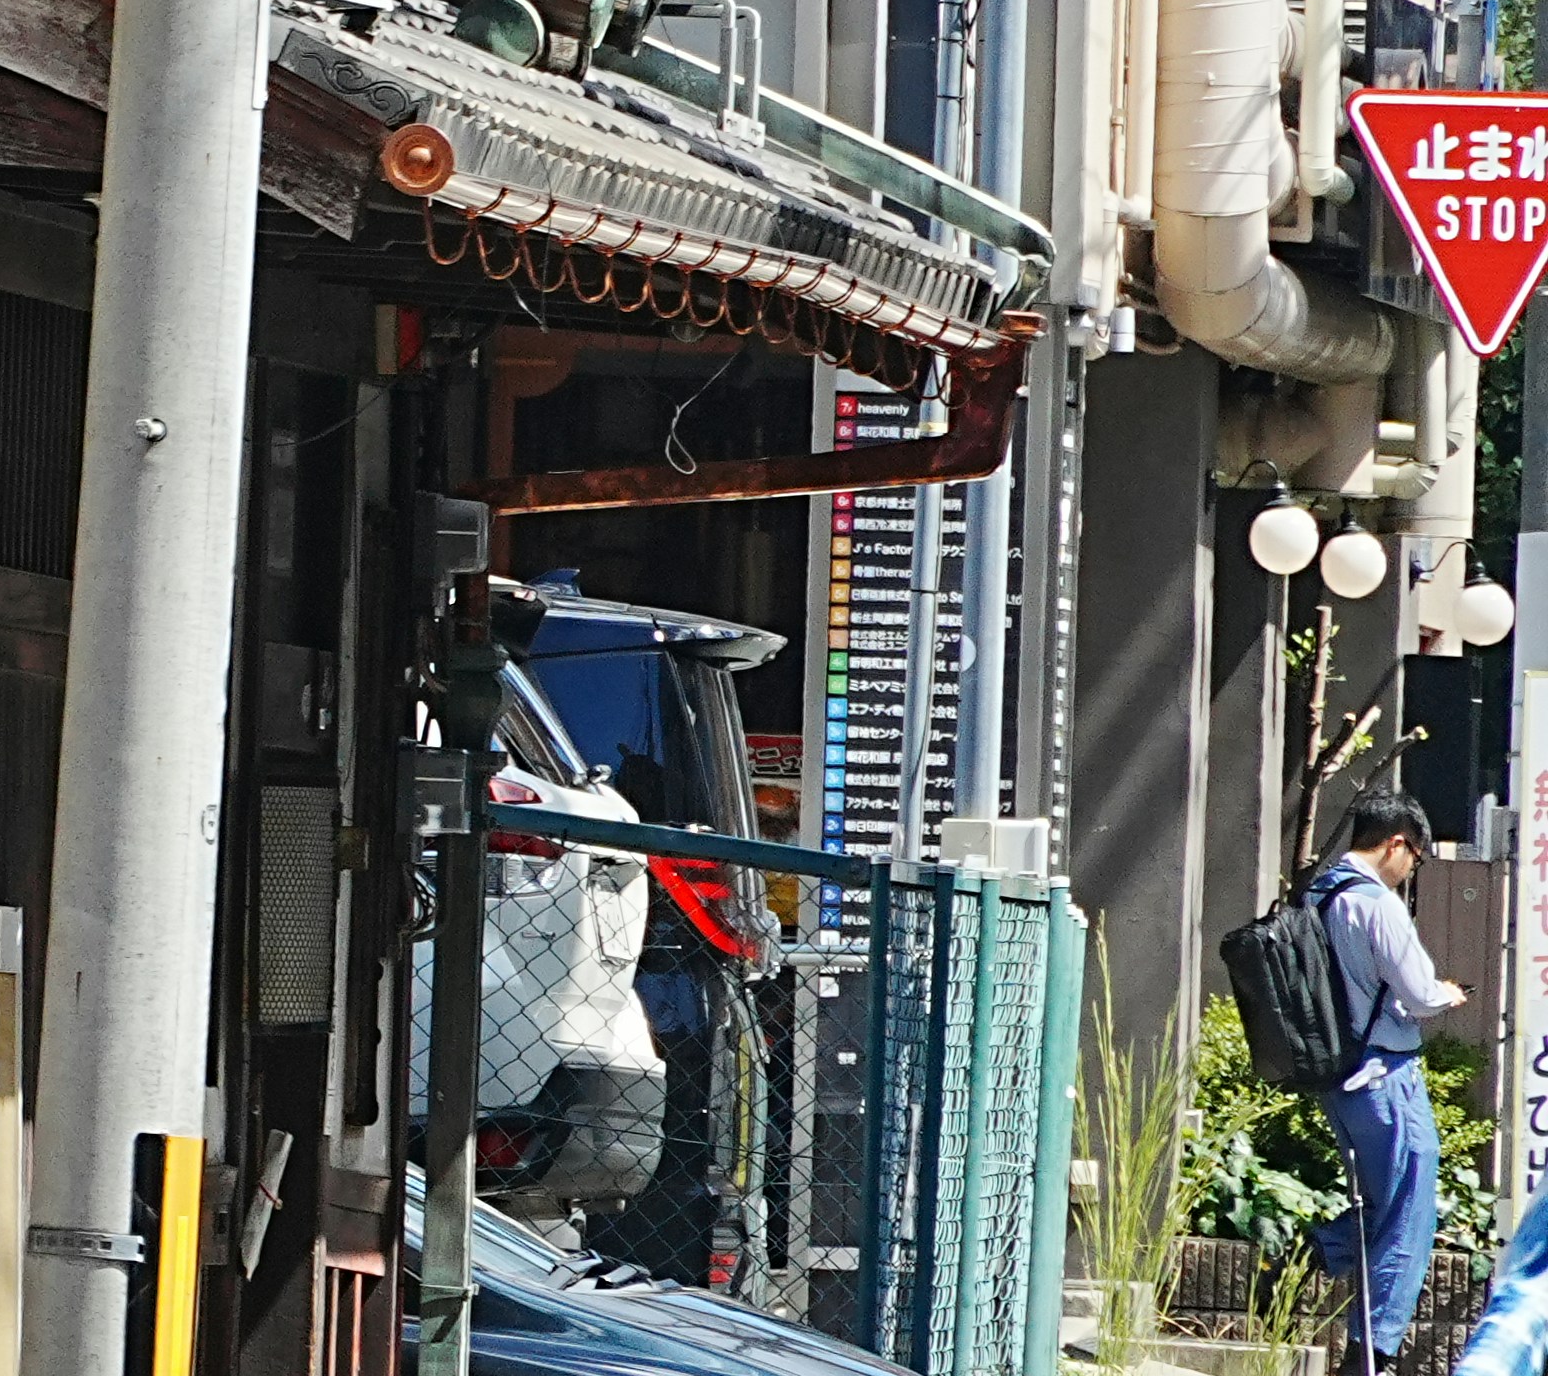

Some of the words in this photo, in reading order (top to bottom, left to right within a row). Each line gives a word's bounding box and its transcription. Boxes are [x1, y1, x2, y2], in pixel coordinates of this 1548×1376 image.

[1437, 195, 1546, 242] STOP
[857, 403, 909, 416] heavenly
[874, 544, 913, 556] Factor
